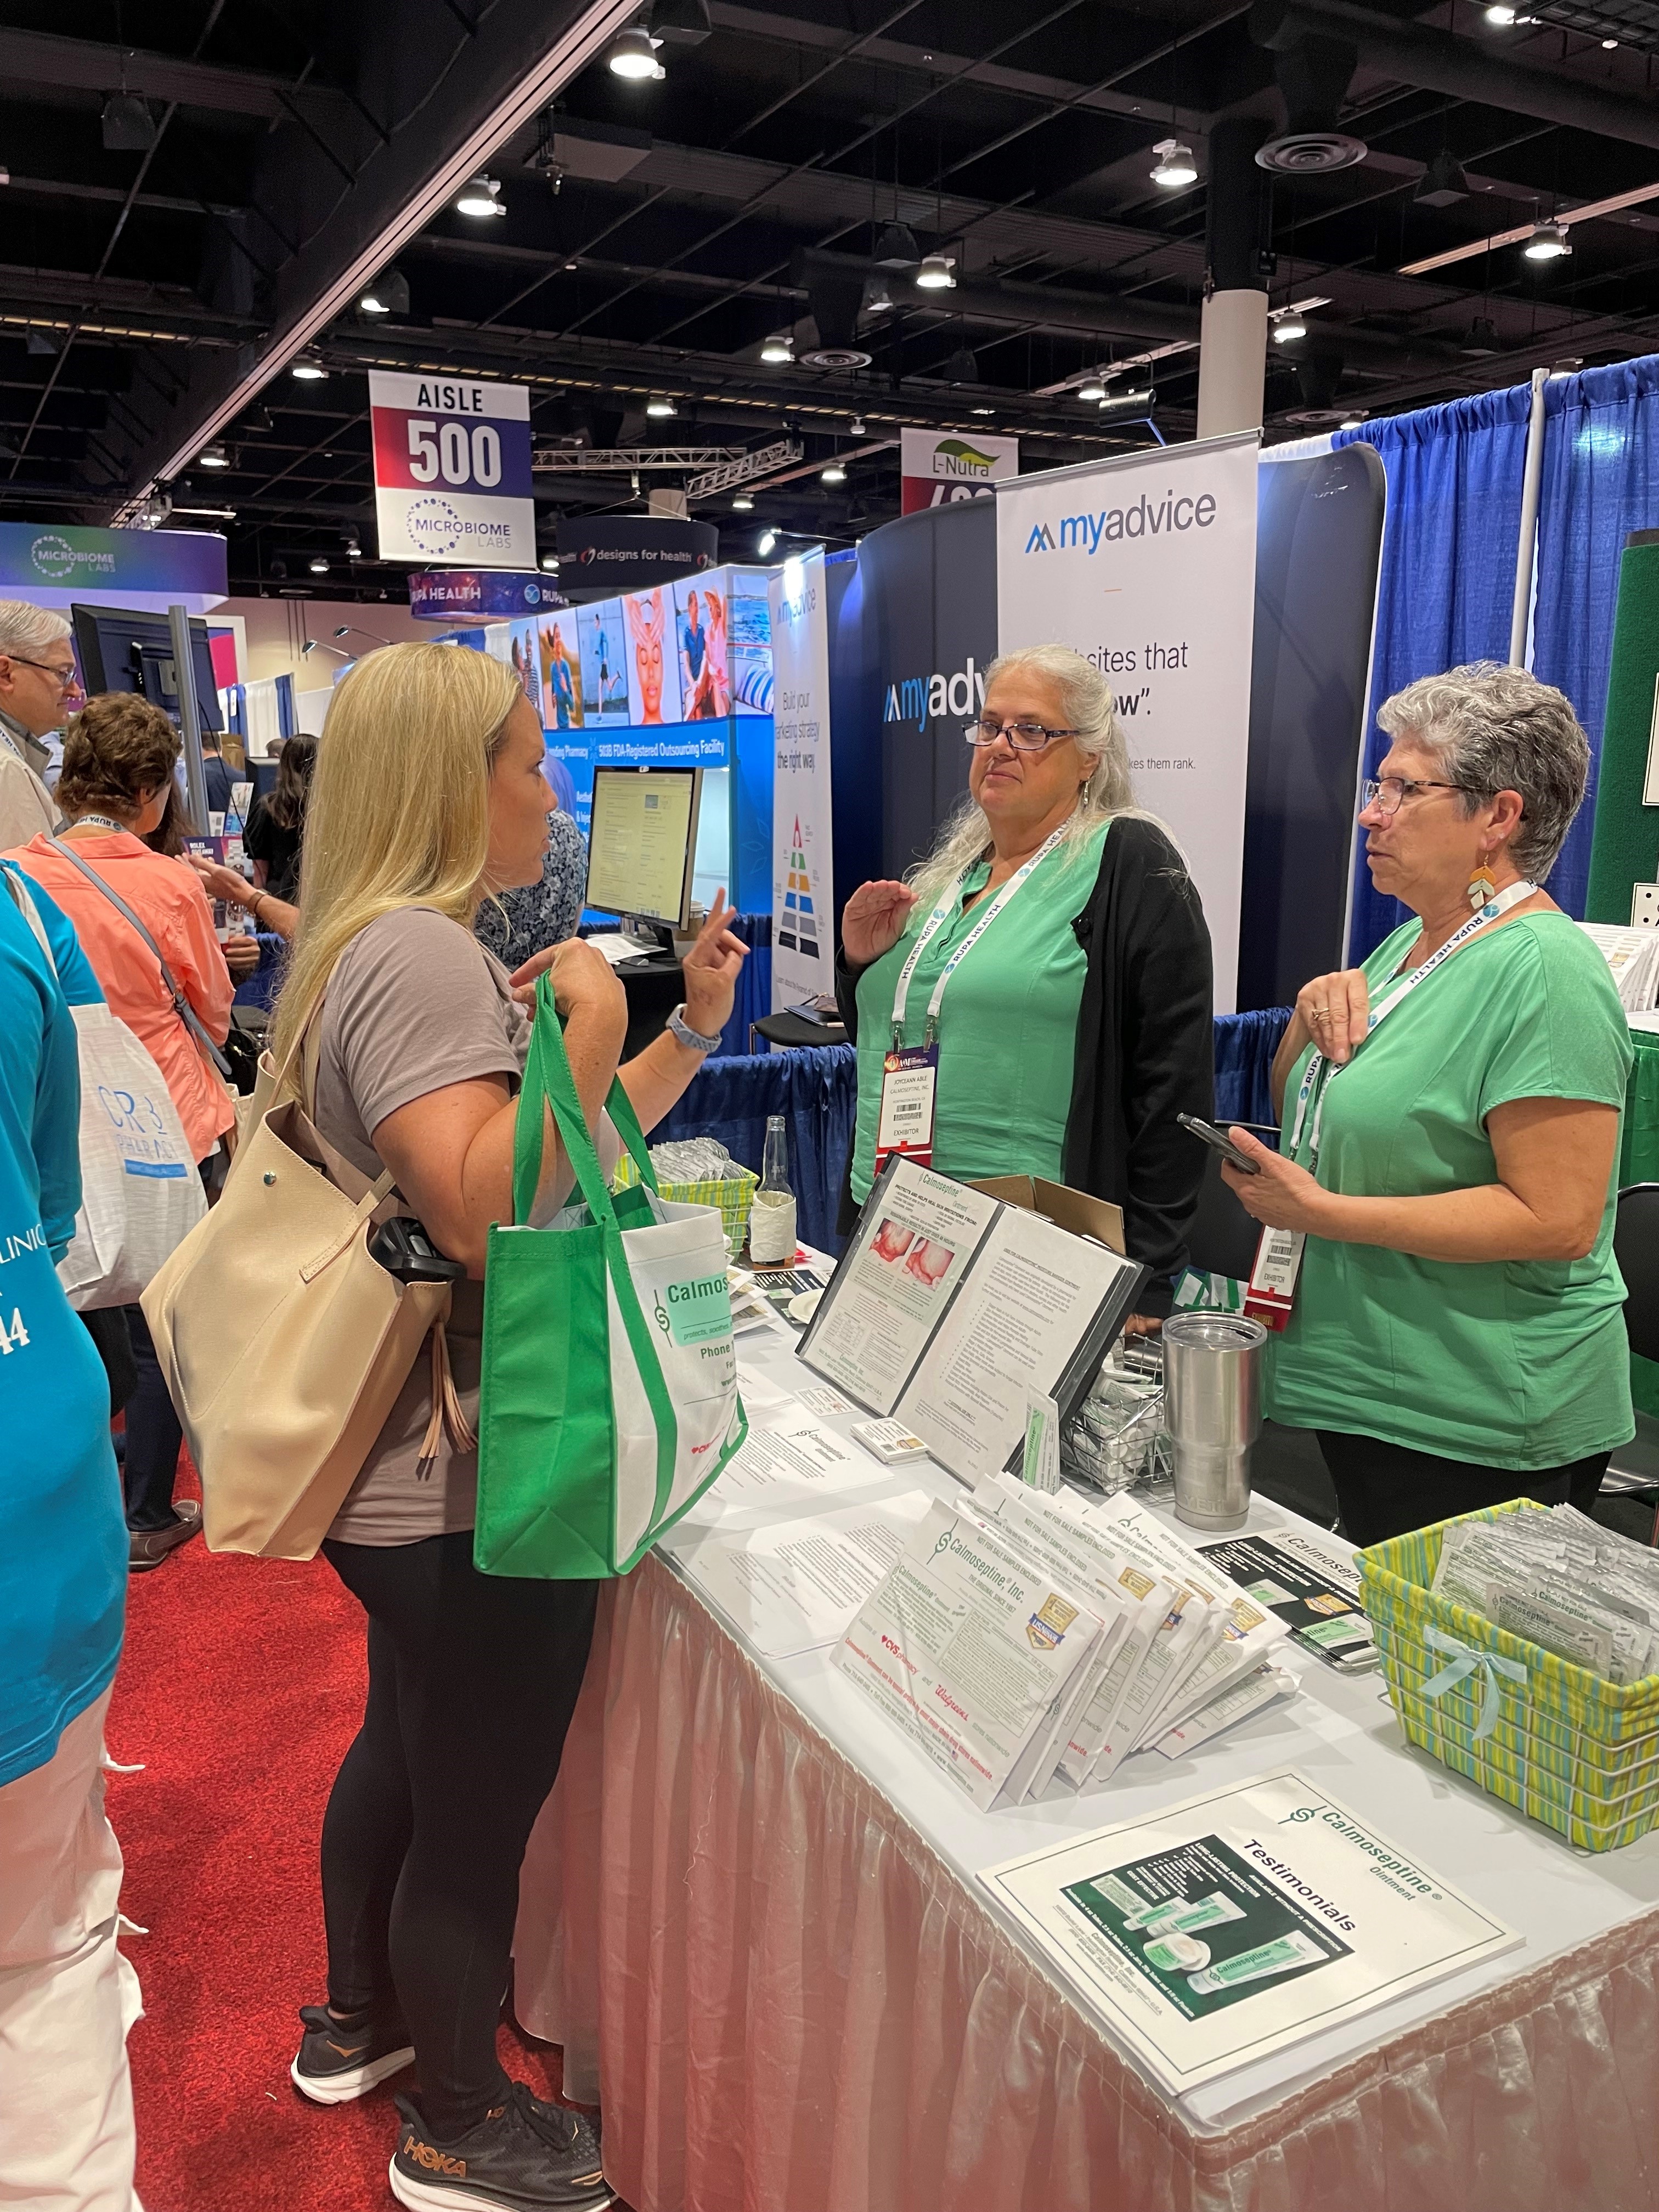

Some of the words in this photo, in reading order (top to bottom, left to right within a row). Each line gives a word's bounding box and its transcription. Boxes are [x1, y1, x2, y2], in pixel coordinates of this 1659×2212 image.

[417, 384, 483, 413] AISLE
[407, 419, 501, 487] 500
[933, 455, 989, 477] L-Nutra
[415, 518, 511, 537] MICROBIOME
[1060, 489, 1216, 555] myadvice
[477, 536, 511, 549] LABS
[38, 550, 115, 563] MICROBIOME
[87, 562, 116, 573] LABS
[597, 549, 639, 561] designs
[641, 550, 658, 560] for
[660, 550, 692, 562] health
[430, 586, 481, 601] HEALTH
[1145, 642, 1188, 670] that
[659, 741, 699, 758] Outsourcing
[700, 739, 725, 757] Facility
[777, 751, 788, 769] the
[789, 749, 801, 774] right
[1147, 758, 1171, 769] them
[1173, 757, 1196, 769] rank.
[1028, 848, 1049, 867] RUPA
[923, 919, 938, 940] RUPA
[954, 939, 972, 962] RUPA
[970, 903, 1002, 939] HEALTH
[1452, 917, 1483, 941] RUPA
[901, 940, 924, 980] HEALTH
[1409, 944, 1452, 984] HEALTH
[894, 1077, 916, 1086] JOYCEANN
[1306, 1055, 1323, 1084] RUPA
[893, 1128, 919, 1136] EXHIBITOR
[684, 1329, 708, 1340] protects,
[700, 1344, 731, 1359] Phone
[1184, 1494, 1225, 1513] YETI
[1024, 1517, 1035, 1529] NOT
[1032, 1523, 1042, 1534] FOR
[1049, 1536, 1069, 1556] SAMPLES
[1043, 1509, 1053, 1520] NOT
[1051, 1515, 1062, 1526] FOR
[1060, 1521, 1073, 1533] SALE
[1071, 1527, 1093, 1547] SAMPLES
[976, 1536, 986, 1546] NOT
[984, 1542, 994, 1551] FOR
[992, 1547, 1003, 1559] SALE
[1002, 1554, 1022, 1572] SAMPLES
[1007, 1582, 1025, 1604] Inc.
[885, 1640, 900, 1655] CVS
[922, 1675, 933, 1686] and
[1322, 1811, 1433, 1894] Calmoseptine
[1243, 1838, 1357, 1932] Testimonials
[1369, 1866, 1417, 1901] Ointment
[403, 2135, 467, 2179] HOKA
